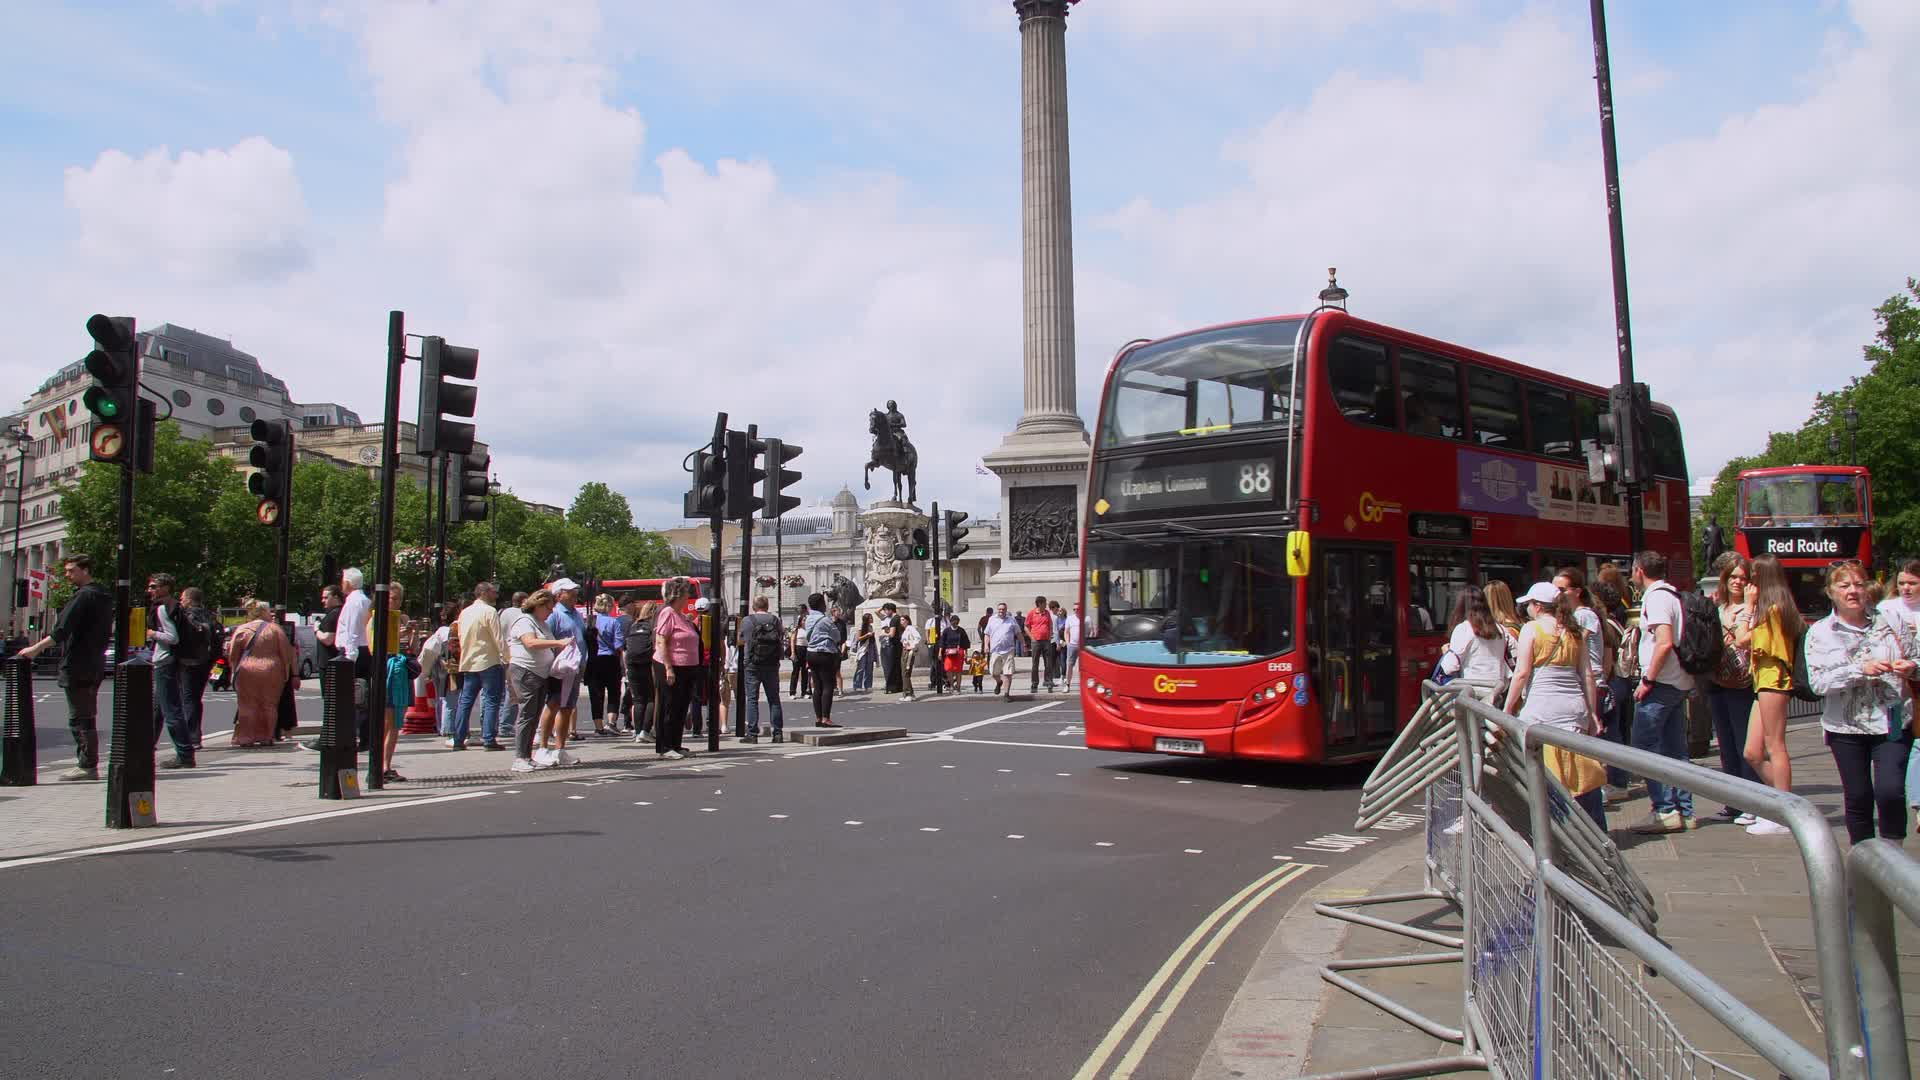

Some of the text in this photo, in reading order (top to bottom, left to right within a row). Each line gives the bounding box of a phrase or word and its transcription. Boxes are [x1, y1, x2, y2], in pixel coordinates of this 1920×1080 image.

[1239, 462, 1271, 495] 88
[1768, 539, 1838, 553] Red Route
[1154, 674, 1177, 694] Go
